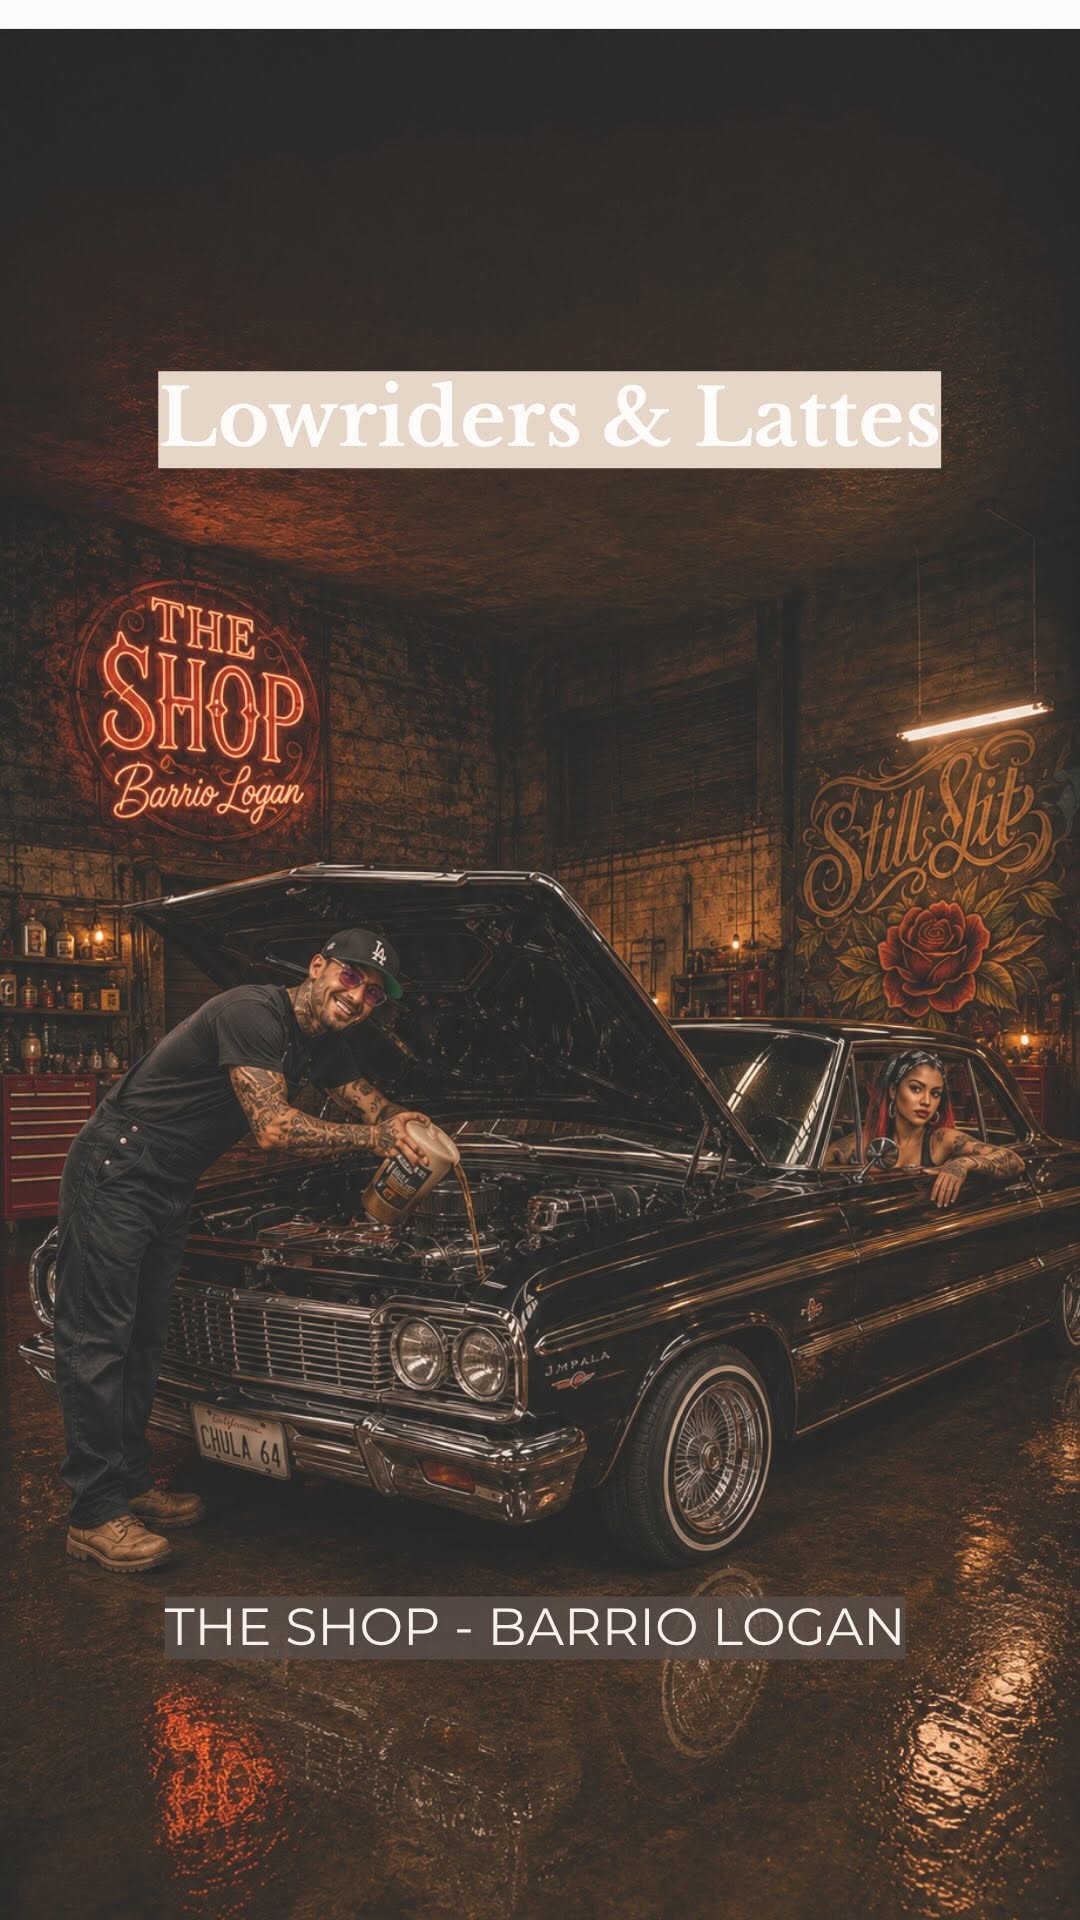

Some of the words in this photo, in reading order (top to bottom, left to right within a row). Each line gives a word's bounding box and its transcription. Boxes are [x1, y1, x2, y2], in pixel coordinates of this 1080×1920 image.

[151, 596, 255, 660] THE
[102, 630, 304, 763] SHOP
[113, 762, 219, 818] Barrio
[217, 765, 304, 824] Logan
[803, 785, 936, 918] Still
[371, 940, 387, 966] LA
[200, 1424, 252, 1461] CHULA
[260, 1439, 281, 1468] 64
